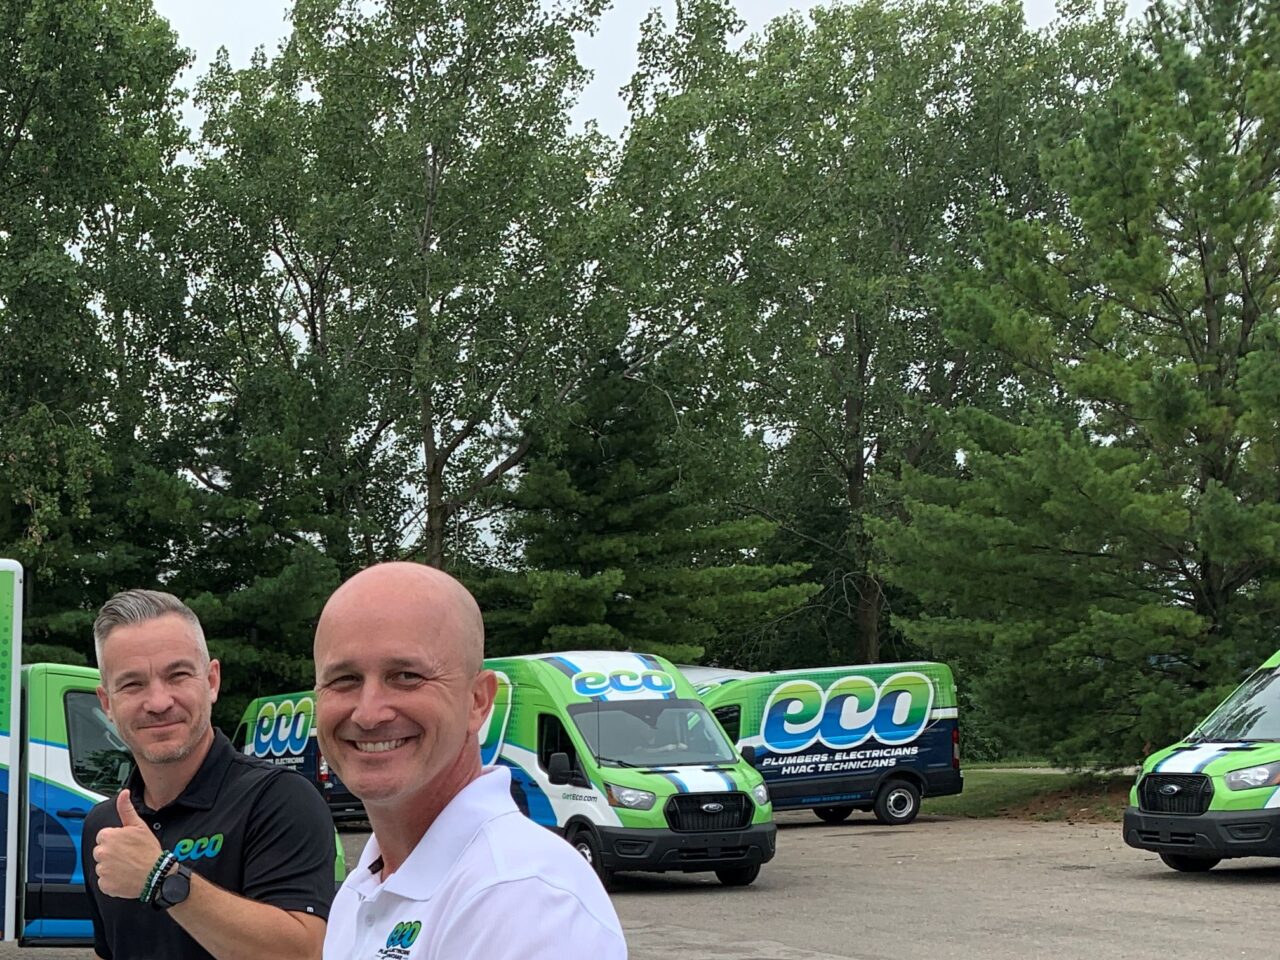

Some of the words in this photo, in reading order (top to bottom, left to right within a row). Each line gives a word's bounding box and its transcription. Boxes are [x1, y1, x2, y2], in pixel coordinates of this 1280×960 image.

[572, 669, 675, 696] eco
[253, 697, 314, 757] eco
[760, 672, 934, 754] eco
[762, 753, 828, 766] PLUMBERS
[835, 746, 918, 761] ELECTRICIANS
[781, 764, 814, 775] HVAC
[817, 758, 897, 773] TECHNICIANS
[173, 833, 224, 862] eco
